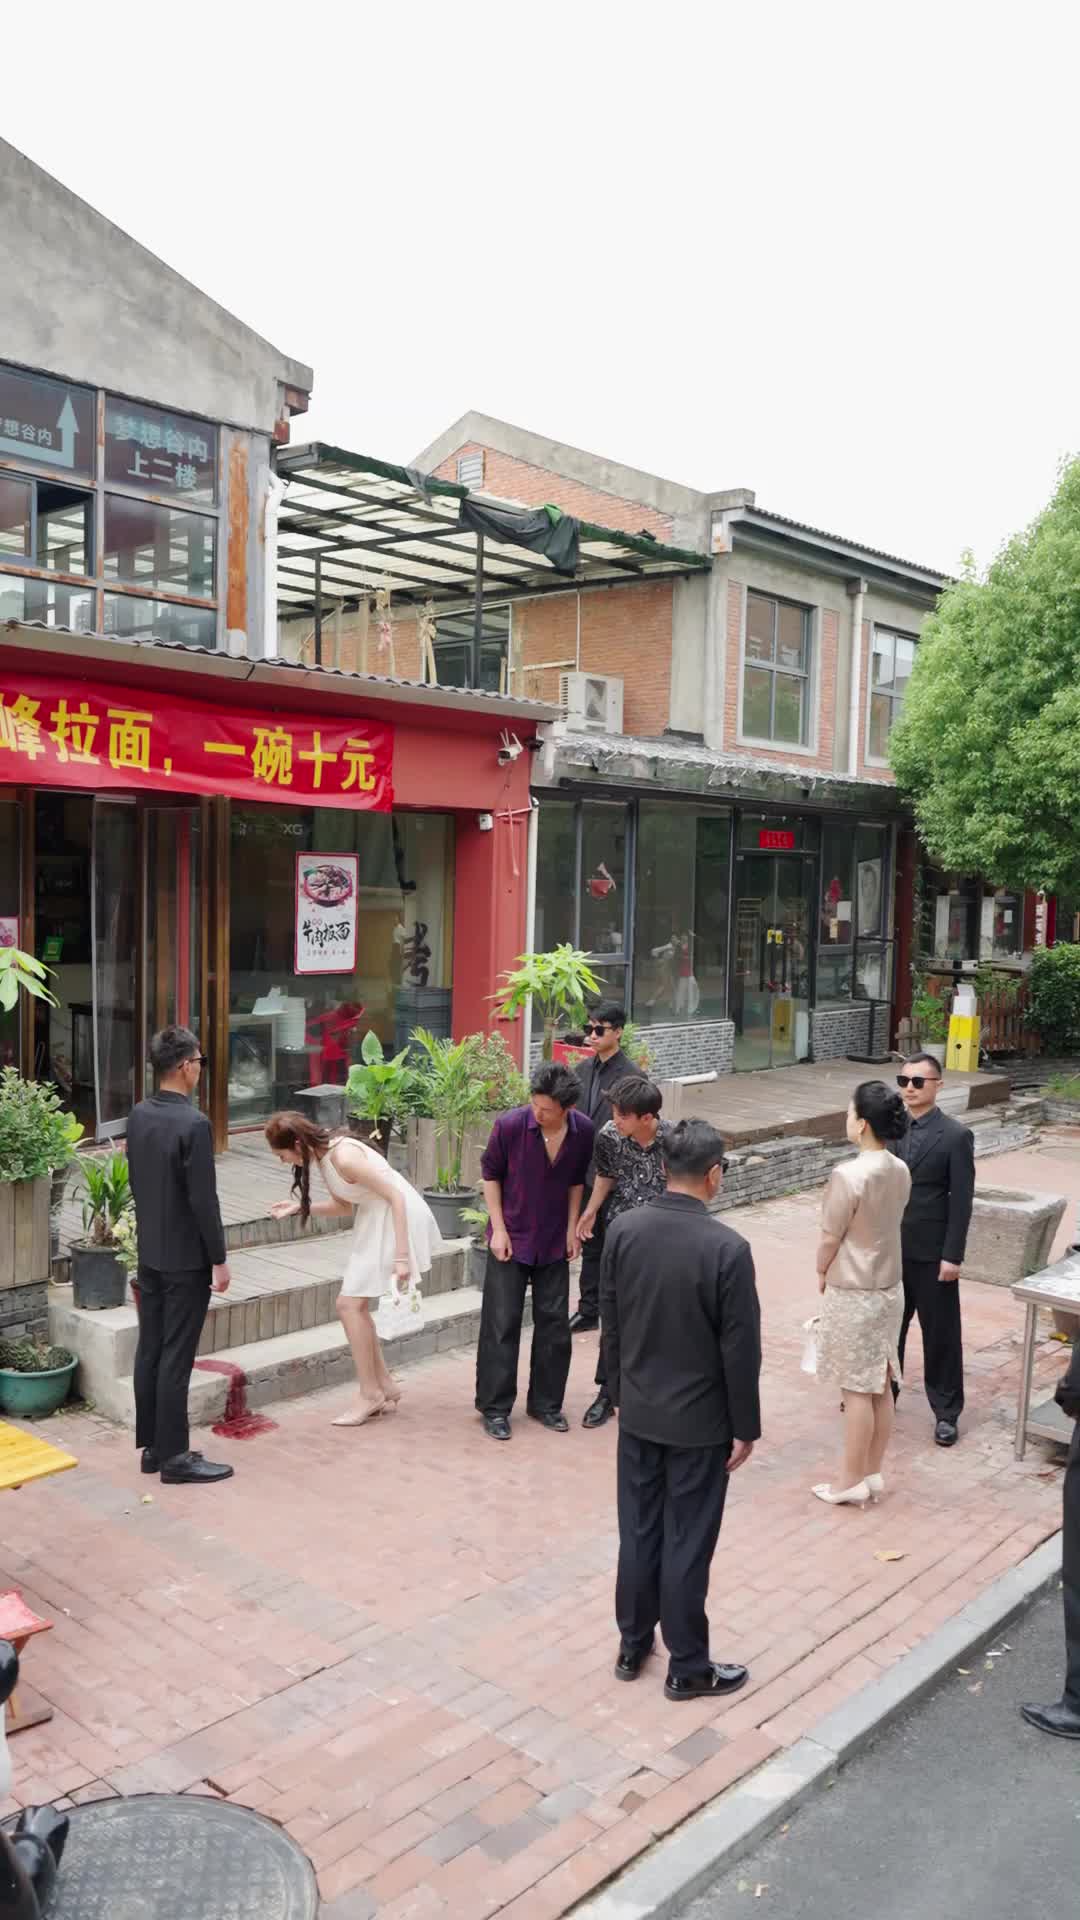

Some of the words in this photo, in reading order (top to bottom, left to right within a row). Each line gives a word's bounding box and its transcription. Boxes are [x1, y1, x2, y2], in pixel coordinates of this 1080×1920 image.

[0, 417, 52, 446] 想谷内
[128, 451, 197, 489] 上二楼
